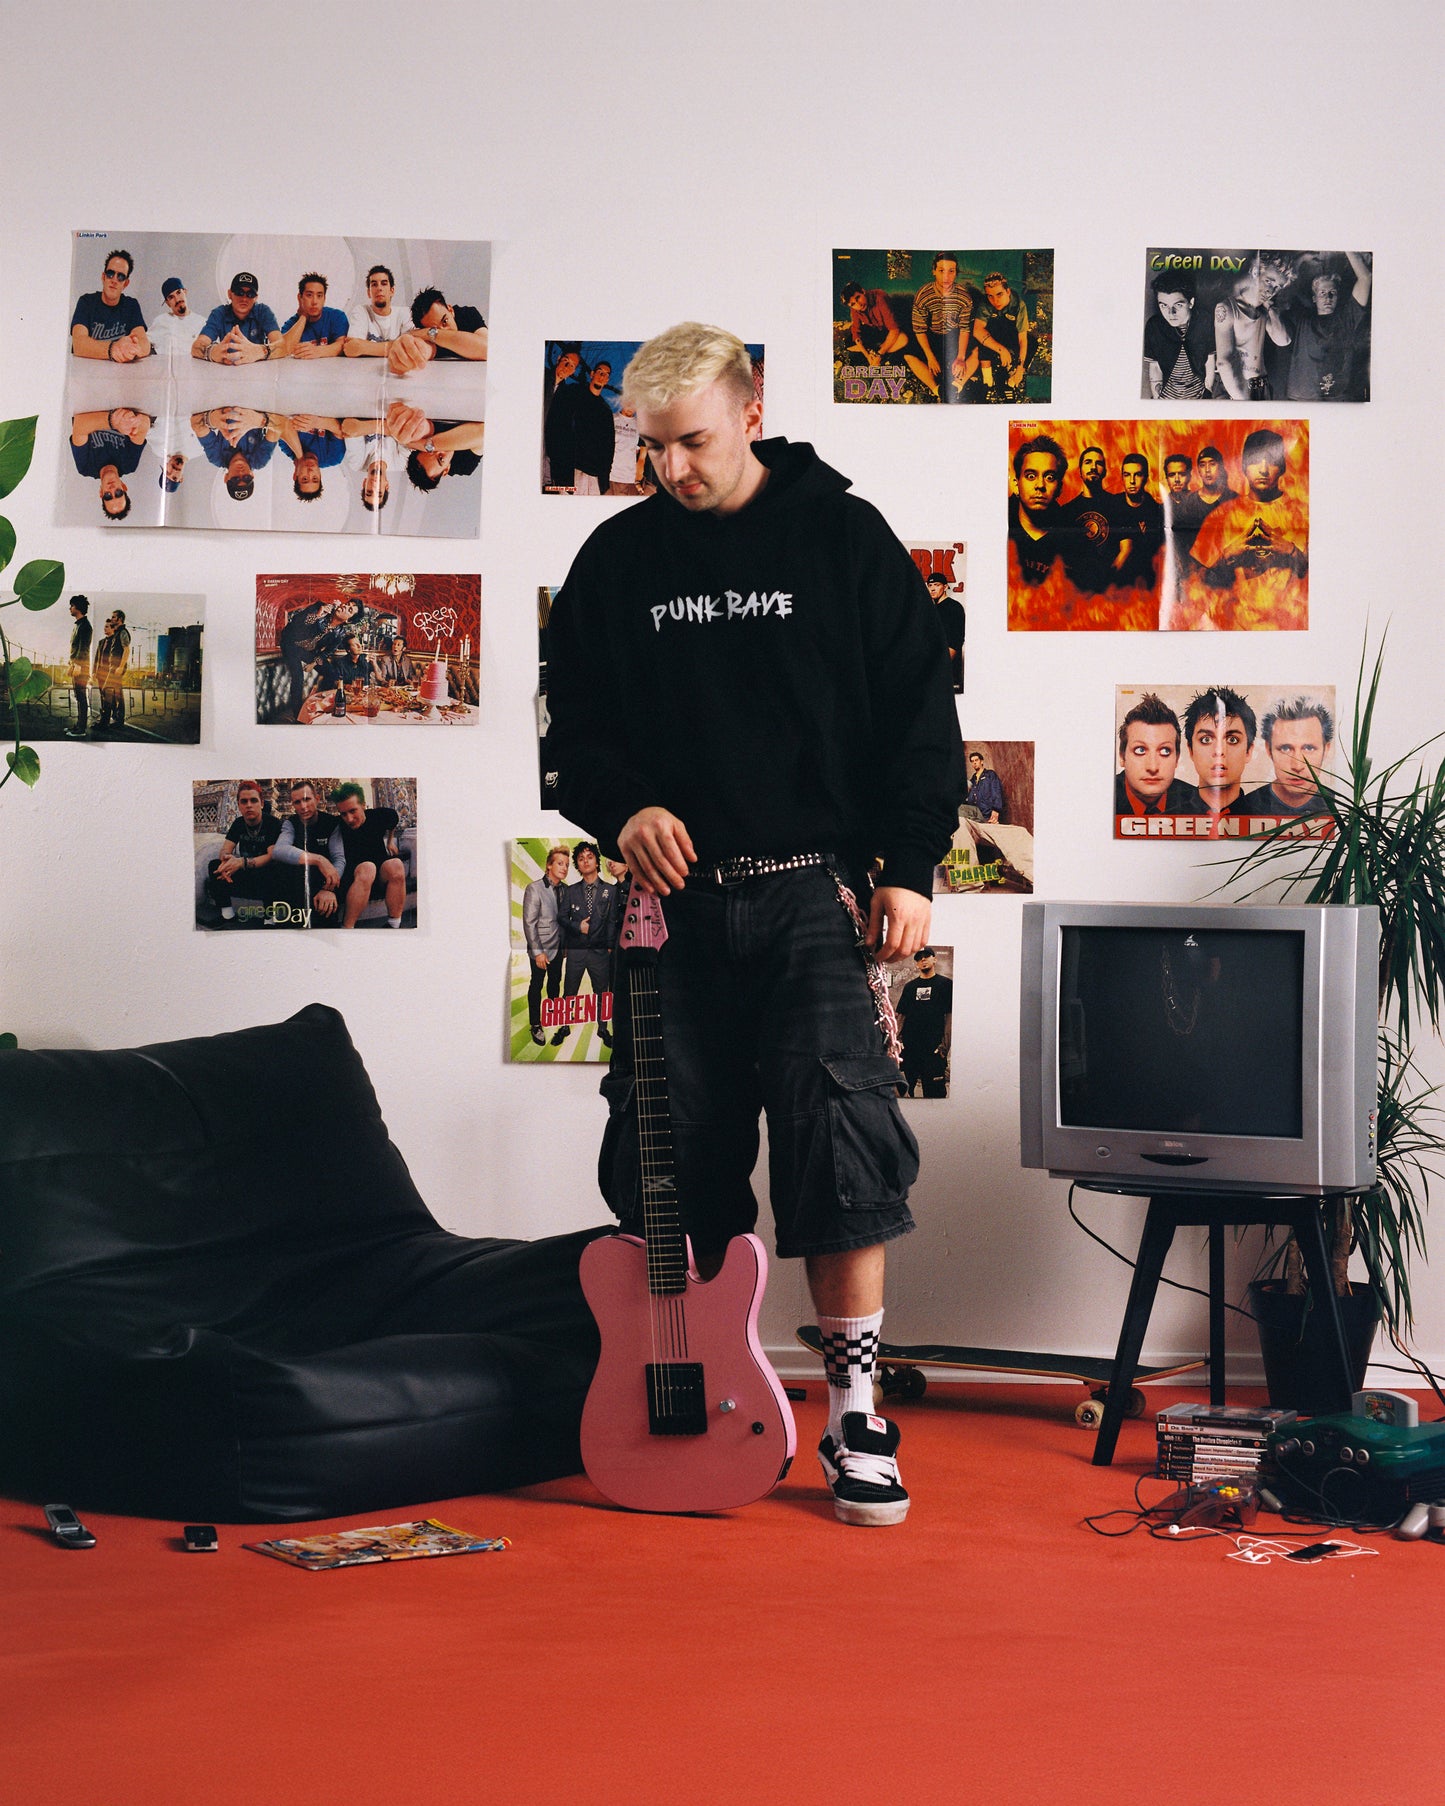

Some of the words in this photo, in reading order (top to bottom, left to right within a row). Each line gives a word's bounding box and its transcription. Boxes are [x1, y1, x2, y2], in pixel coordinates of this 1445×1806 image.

[1150, 254, 1202, 271] Green
[91, 322, 126, 340] Matix
[841, 366, 906, 378] GREEN
[844, 378, 906, 399] DAY
[910, 549, 956, 583] RK
[650, 594, 724, 632] PUNK
[724, 589, 793, 620] RAVE
[420, 619, 454, 640] DAY
[1120, 817, 1240, 836] GREEN
[1250, 818, 1330, 837] DAY
[942, 849, 970, 865] IN
[949, 863, 1000, 886] PARK
[541, 993, 598, 1027] GREEN
[601, 991, 614, 1022] D
